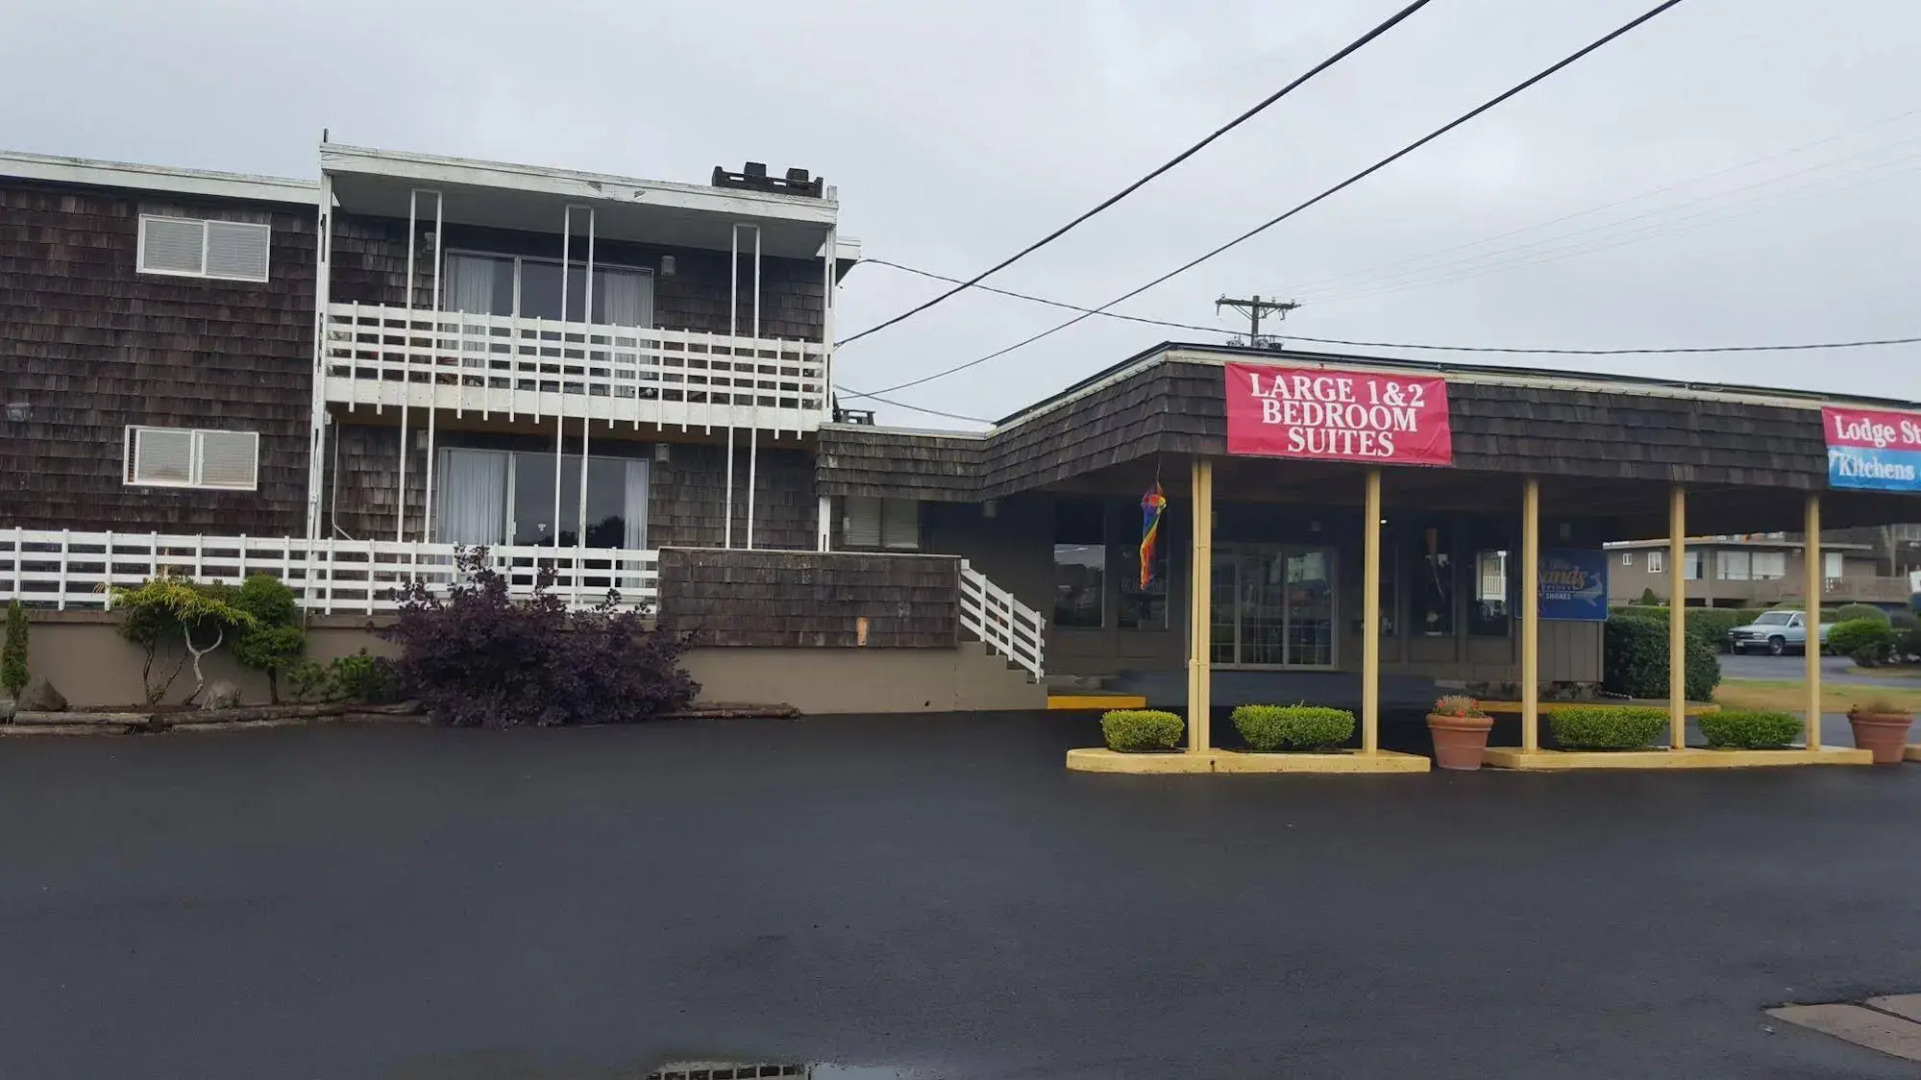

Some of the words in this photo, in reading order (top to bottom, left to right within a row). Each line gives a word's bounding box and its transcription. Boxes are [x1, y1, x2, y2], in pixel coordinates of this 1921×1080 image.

[1250, 373, 1356, 403] LARGE
[1367, 380, 1425, 407] 1&2
[1262, 399, 1418, 432] BEDROOM
[1834, 415, 1897, 448] Lodge
[1288, 426, 1395, 458] SUITES
[1839, 453, 1915, 480] Kitchens
